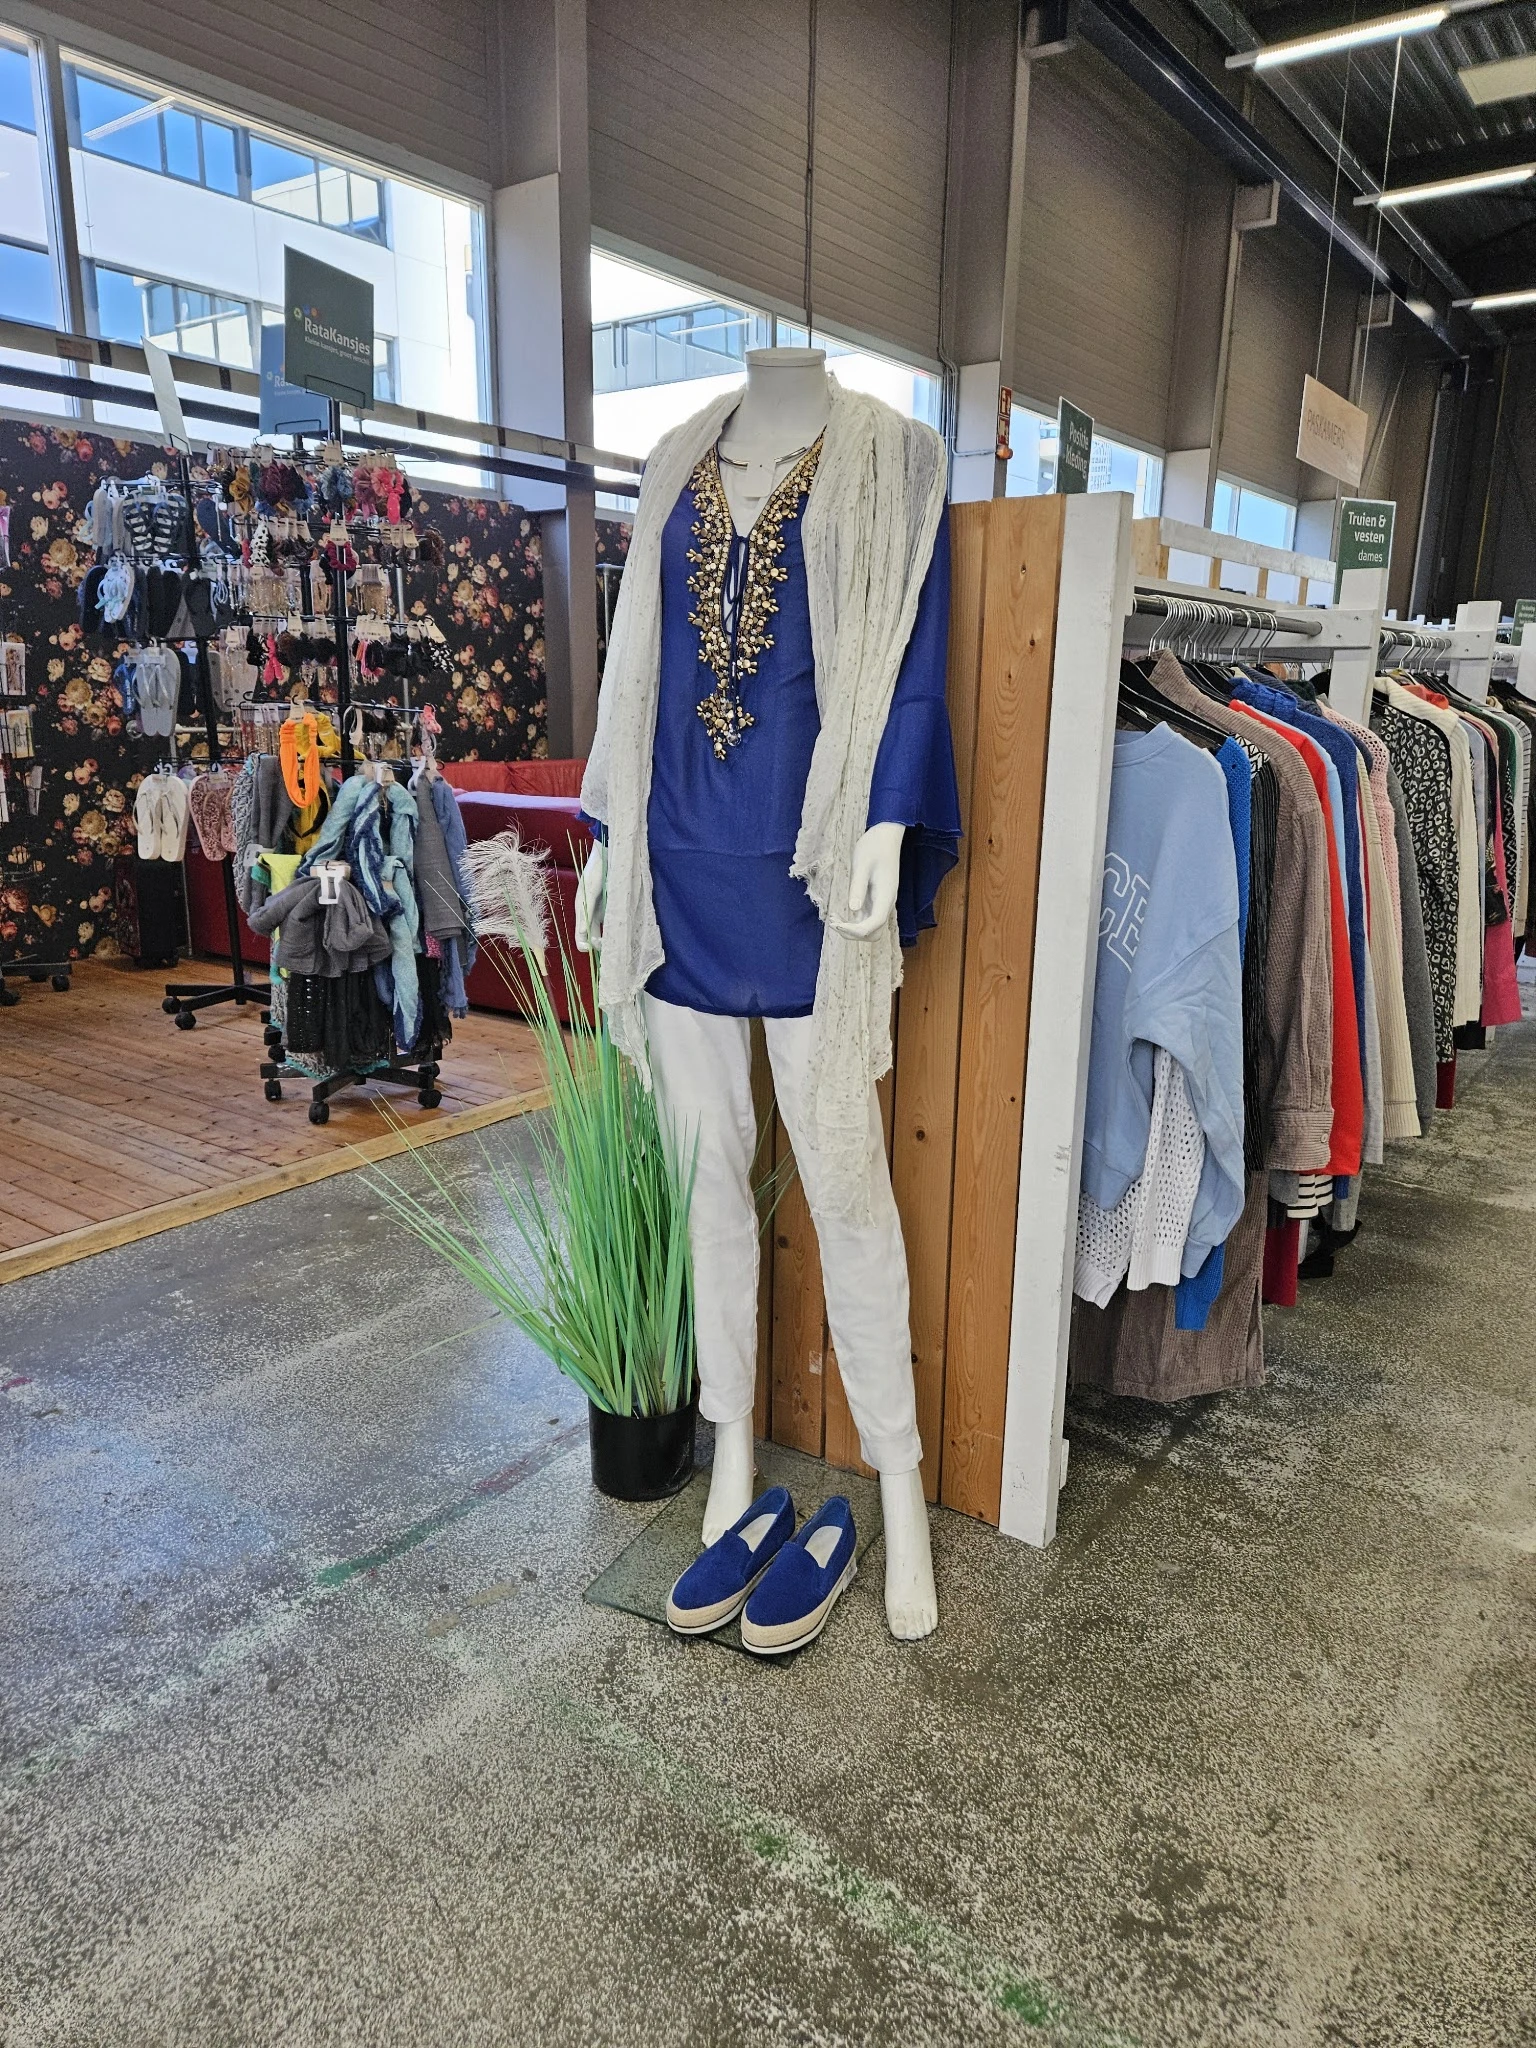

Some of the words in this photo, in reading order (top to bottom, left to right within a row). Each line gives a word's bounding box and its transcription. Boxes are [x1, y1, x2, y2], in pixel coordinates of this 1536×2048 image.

[304, 316, 371, 356] RataKansjes
[1348, 511, 1377, 527] Truien
[1378, 514, 1387, 528] &
[1354, 530, 1385, 544] vesten
[1358, 549, 1383, 563] dames
